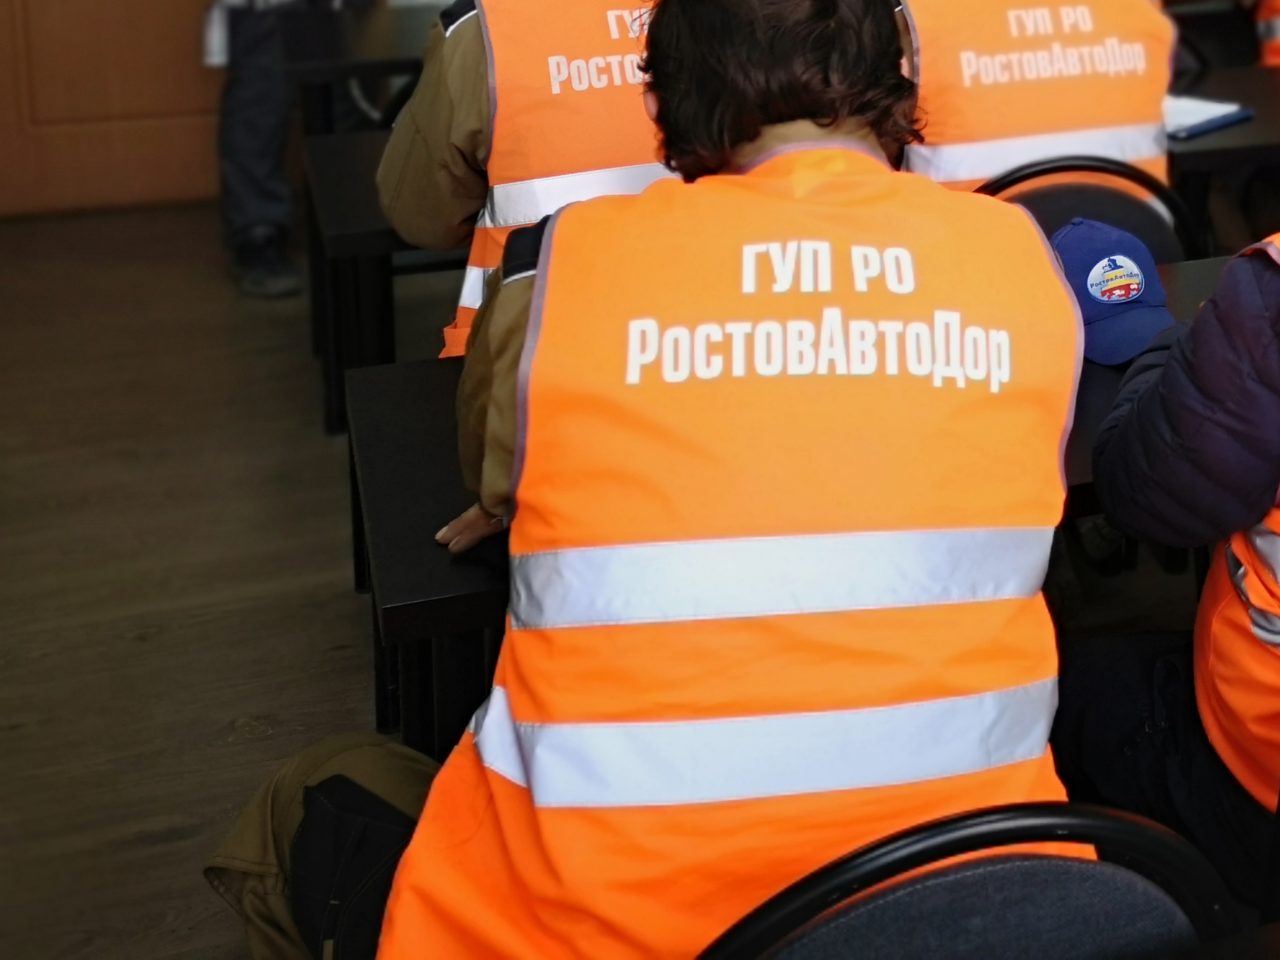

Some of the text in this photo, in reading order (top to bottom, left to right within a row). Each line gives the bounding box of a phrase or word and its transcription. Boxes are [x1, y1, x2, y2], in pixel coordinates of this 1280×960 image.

[1007, 5, 1093, 38] ГУП РО
[959, 37, 1147, 88] РостовАвтоДор
[741, 240, 915, 294] ГУП РО
[625, 307, 1011, 393] РостовАвтоДор
